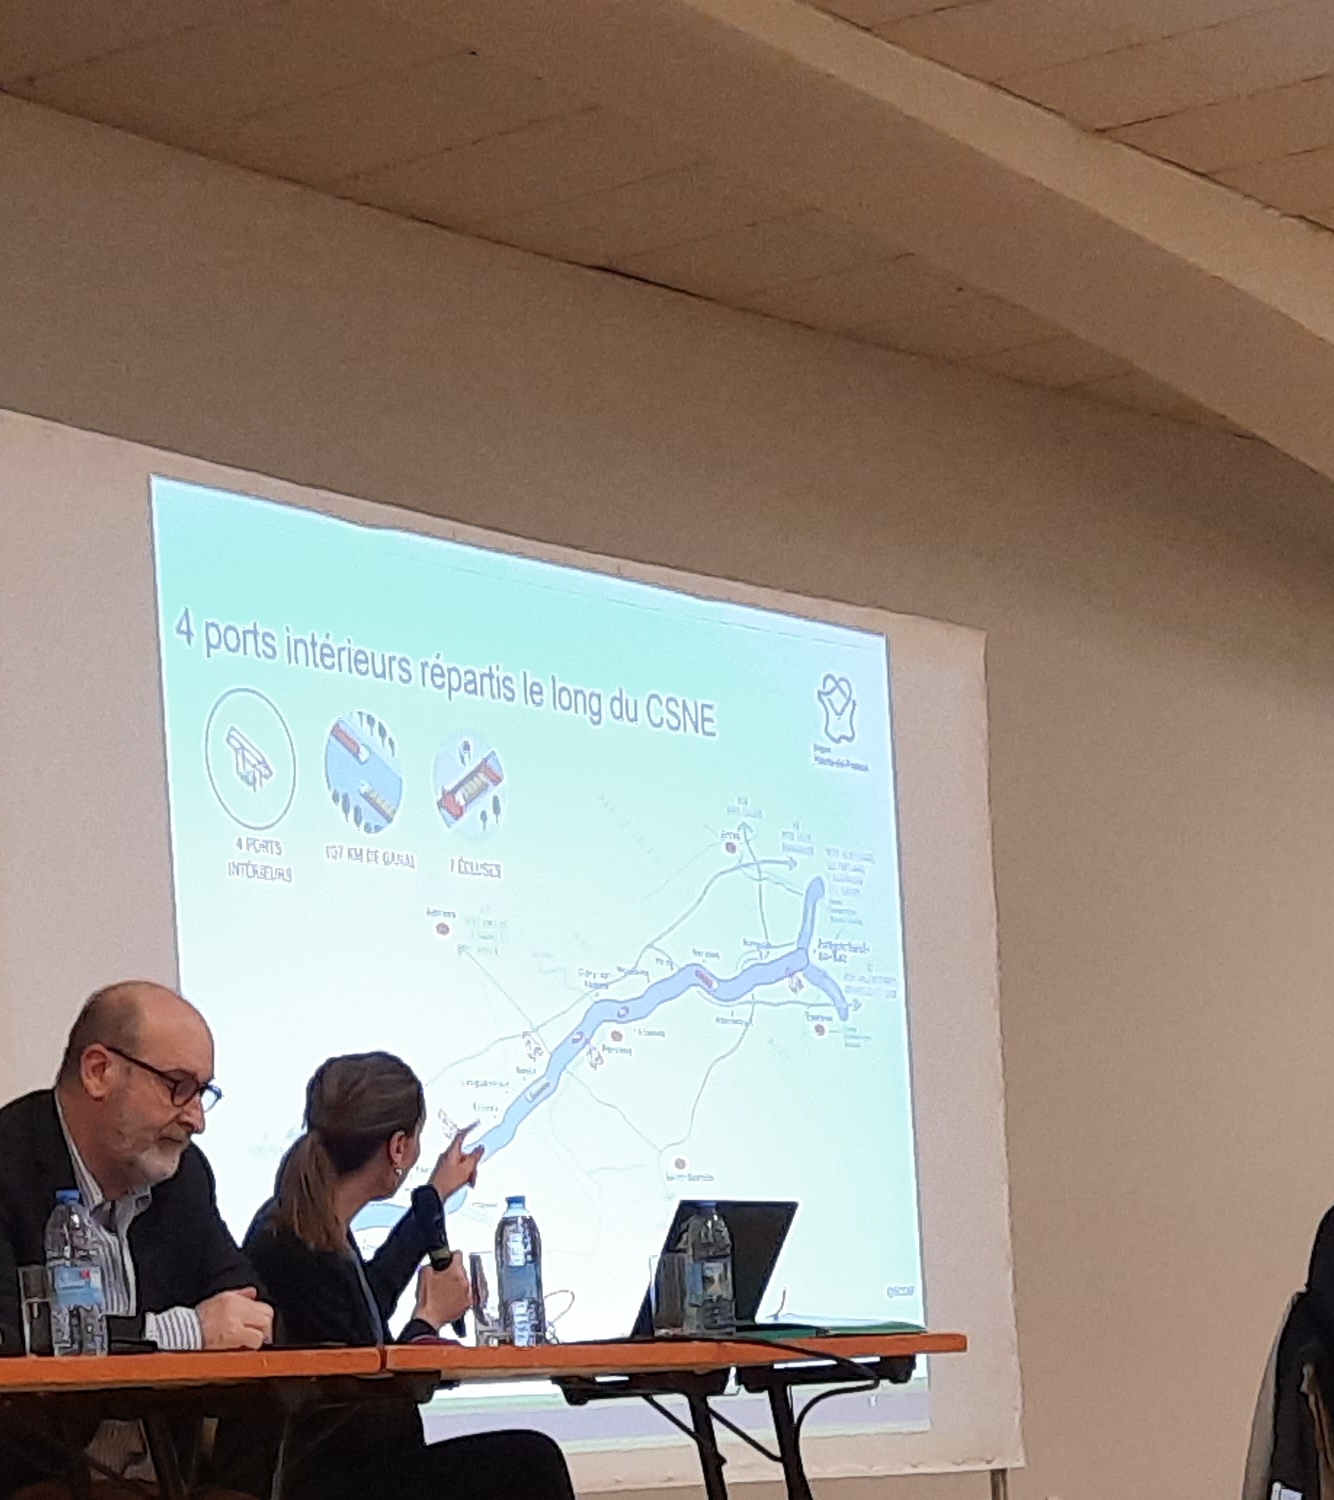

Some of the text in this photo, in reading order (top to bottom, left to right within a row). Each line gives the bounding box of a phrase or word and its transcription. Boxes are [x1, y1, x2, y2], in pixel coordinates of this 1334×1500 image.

[175, 605, 717, 737] 4 ports intérieurs répartis le long du CSNE
